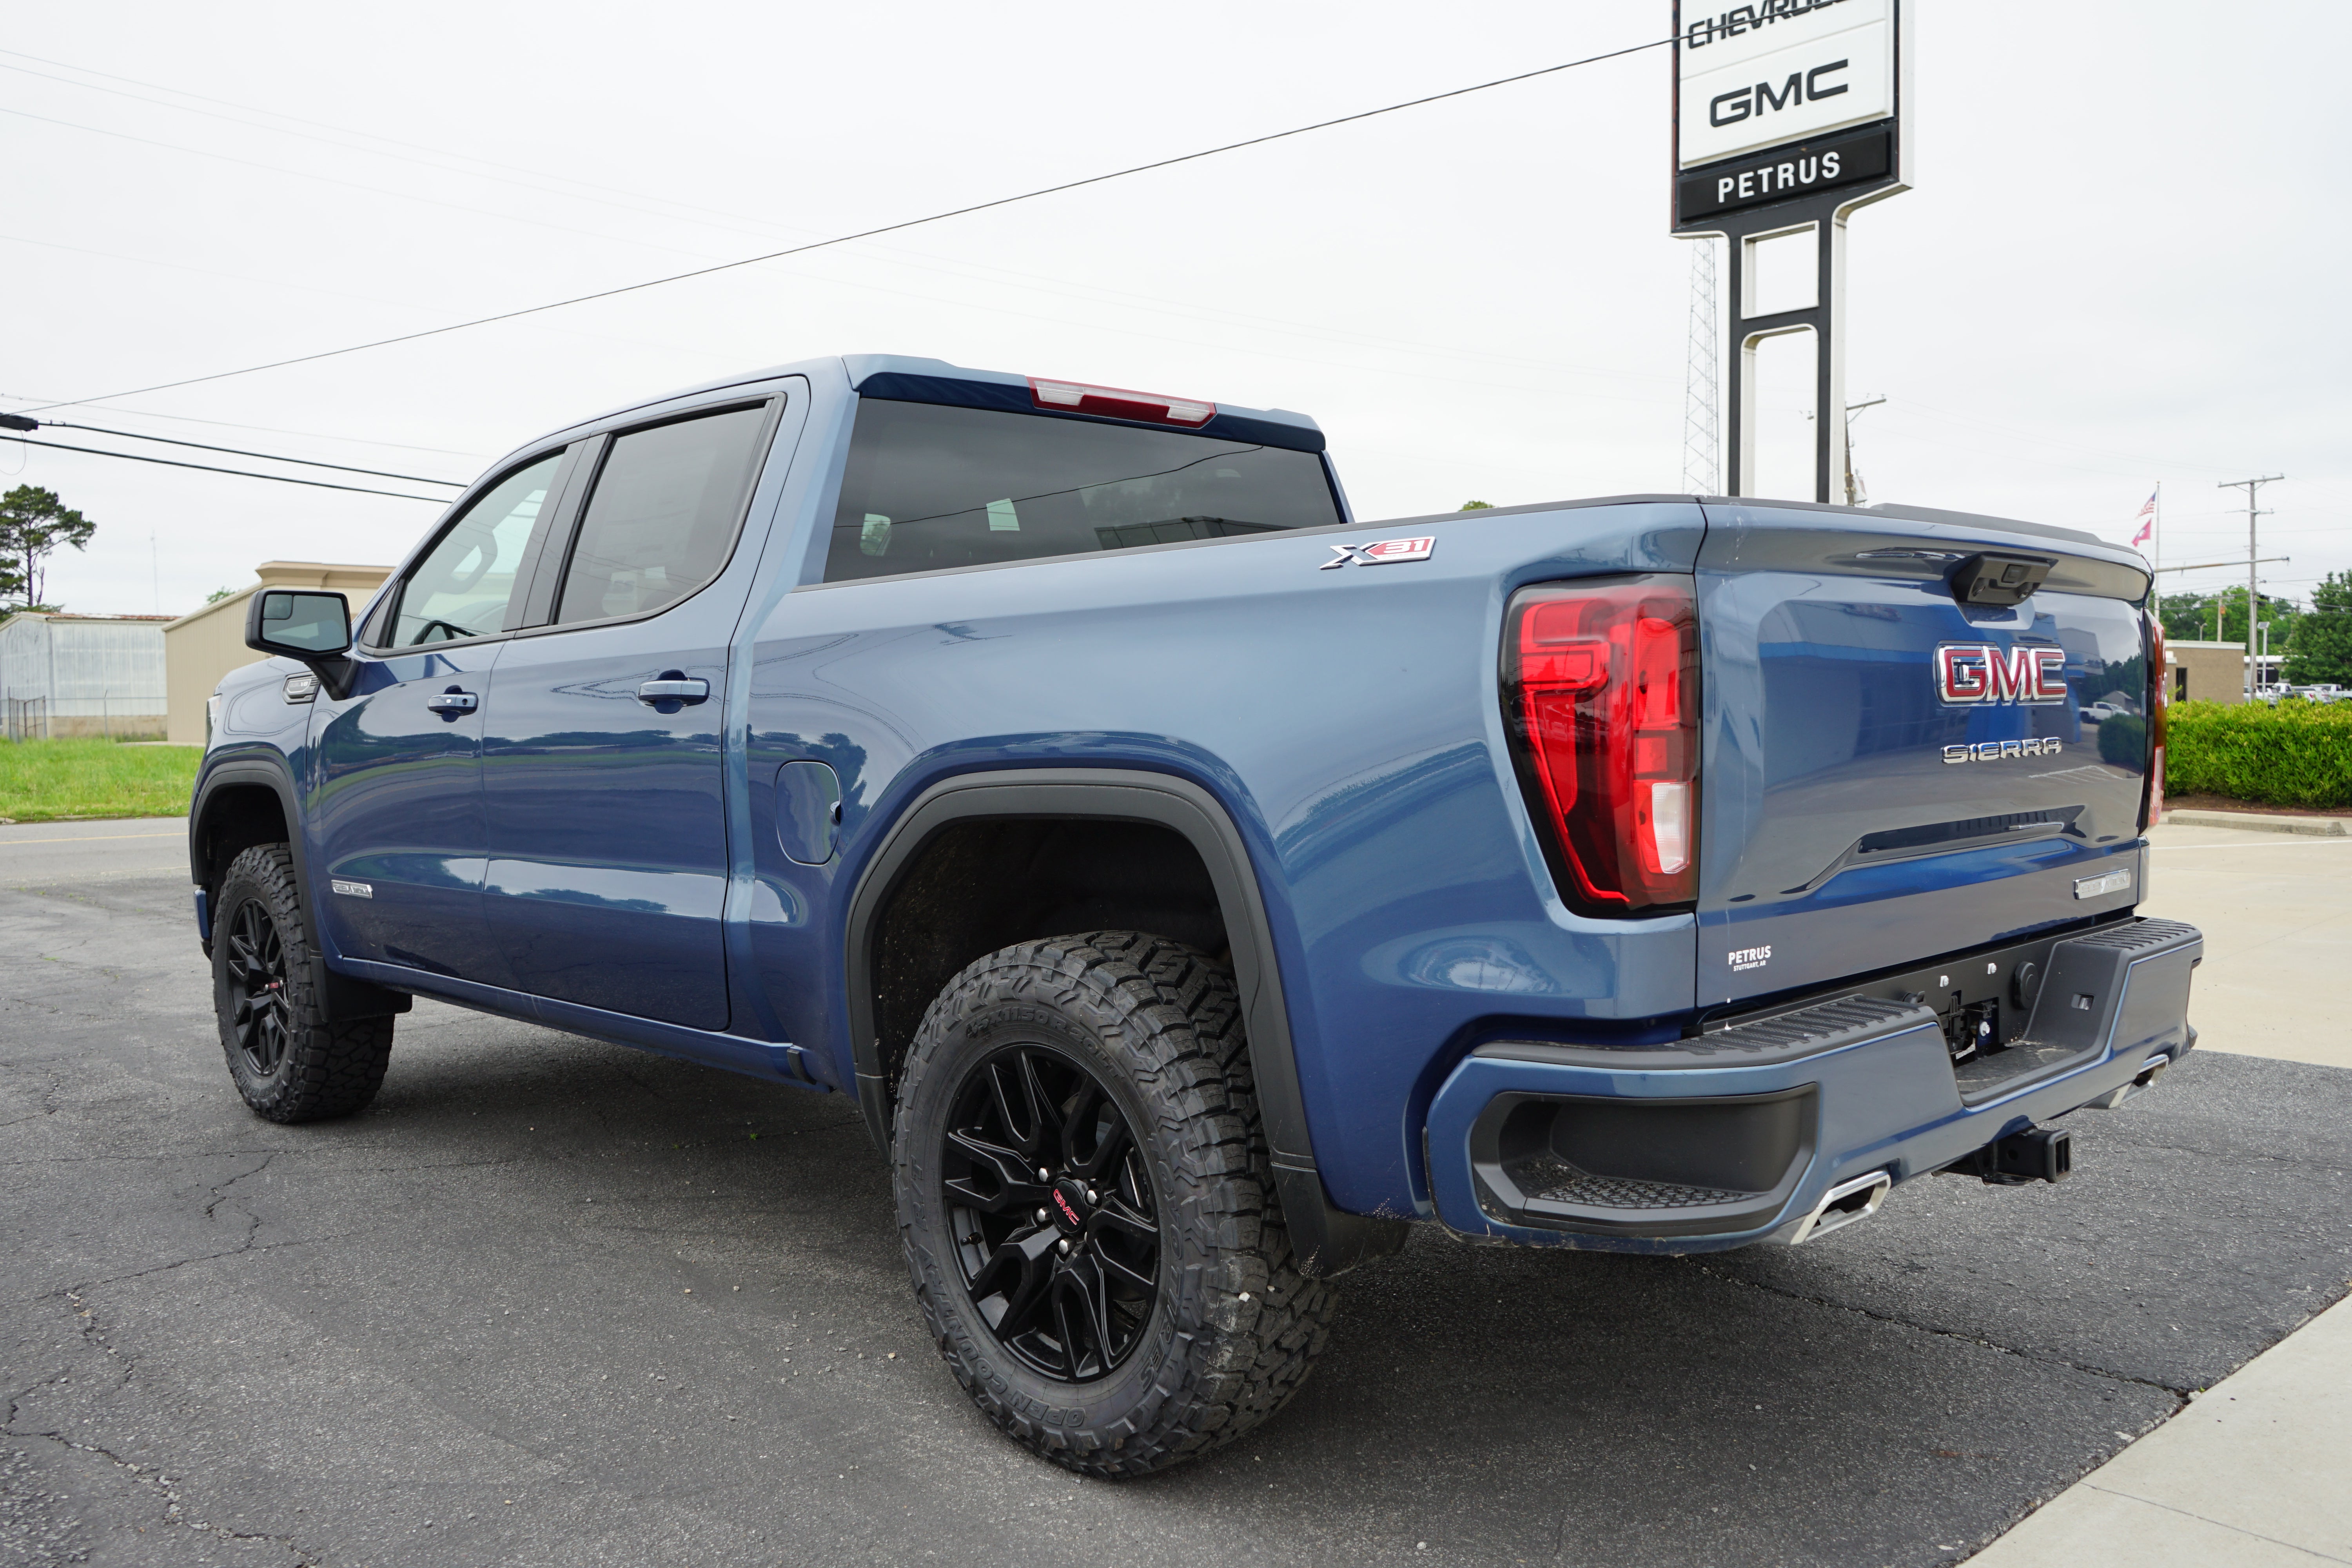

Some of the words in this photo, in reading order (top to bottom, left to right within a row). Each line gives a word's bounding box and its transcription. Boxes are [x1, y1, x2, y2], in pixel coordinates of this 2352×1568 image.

[1710, 58, 1848, 127] GMC
[1718, 152, 1840, 203] PETRUS
[1934, 641, 2068, 706] GMC
[1941, 737, 2062, 764] SIERRA
[1728, 945, 1771, 965] PETRUS
[1733, 961, 1759, 971] STUTTGART,
[1053, 1188, 1080, 1226] GMC
[918, 1243, 1009, 1394] COUNTRY
[1140, 1265, 1182, 1394] TIRES
[1008, 1390, 1085, 1427] OPEN
